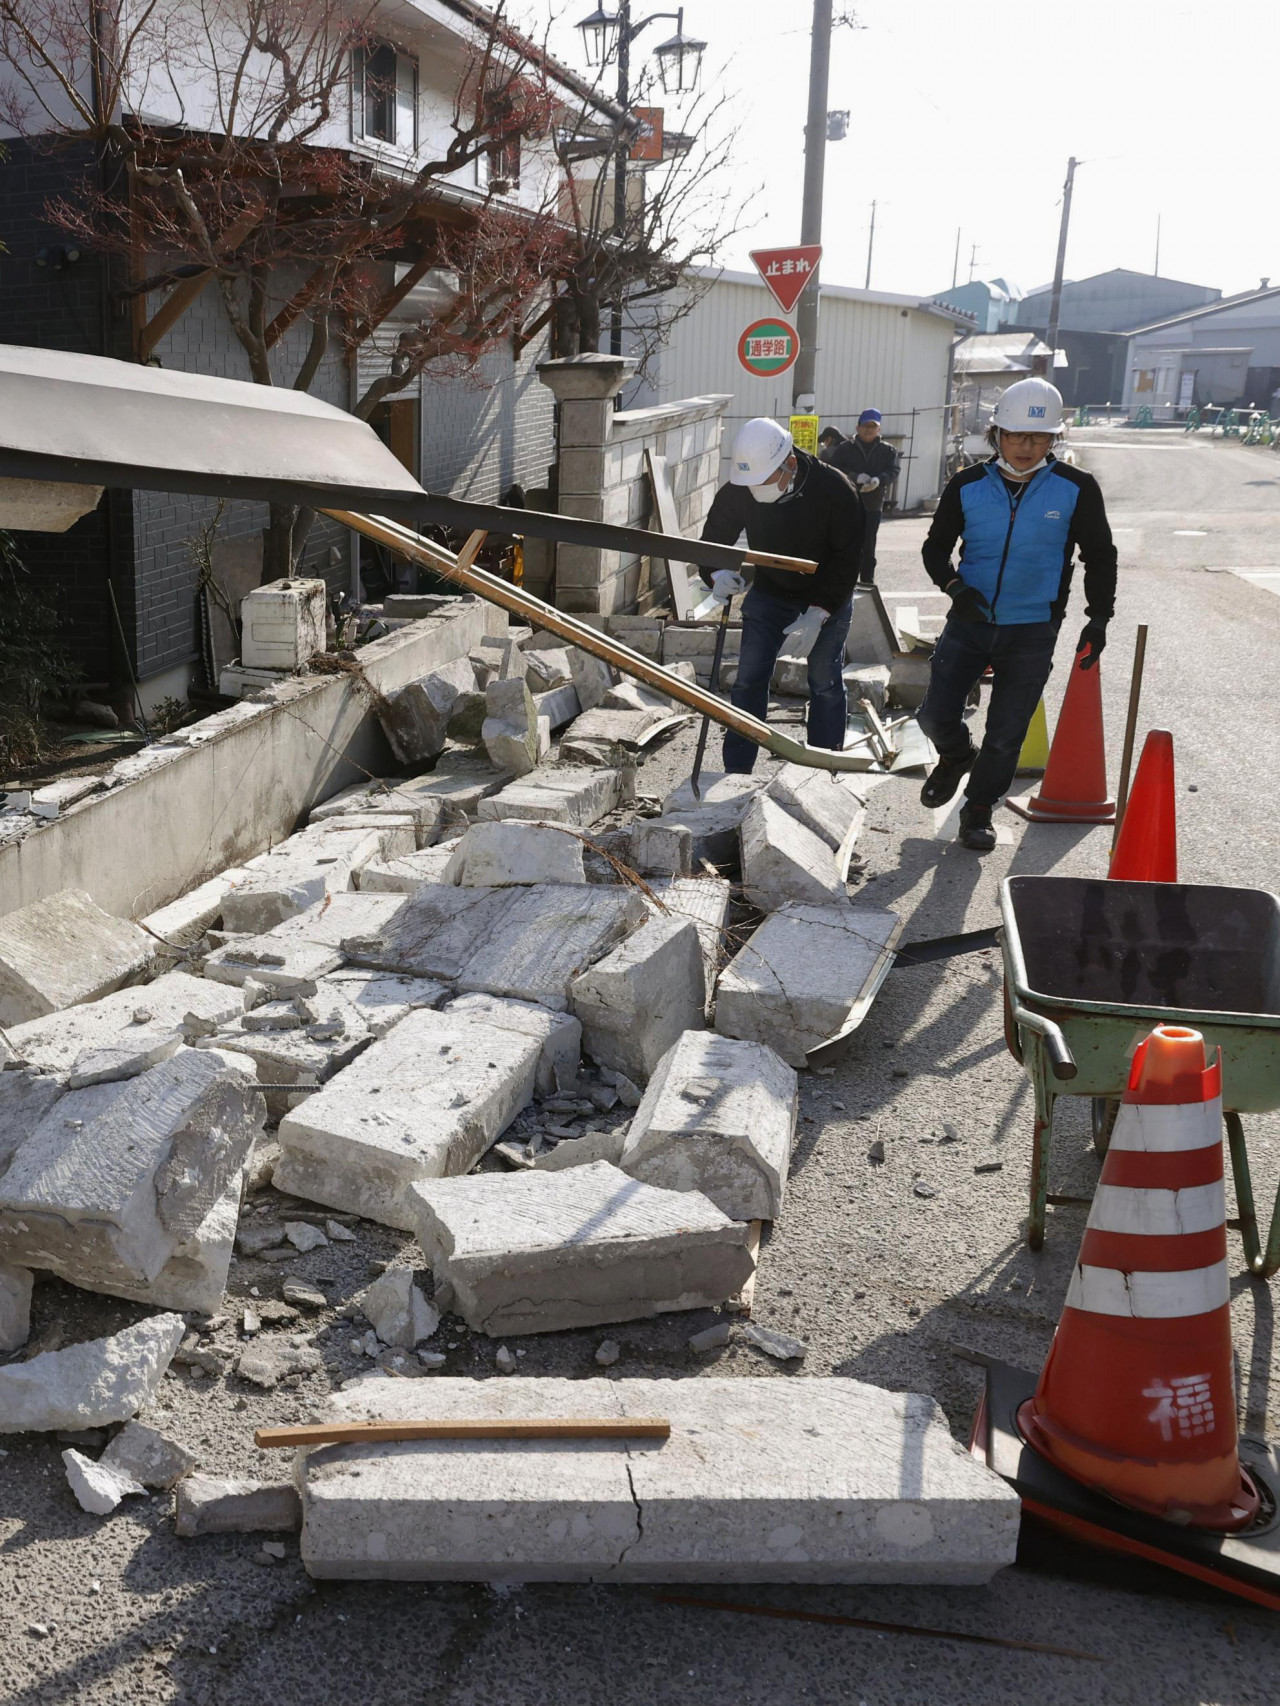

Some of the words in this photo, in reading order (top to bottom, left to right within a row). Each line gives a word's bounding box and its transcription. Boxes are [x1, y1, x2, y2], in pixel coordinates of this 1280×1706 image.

[765, 258, 812, 276] 止まれ
[750, 339, 785, 356] 通学路
